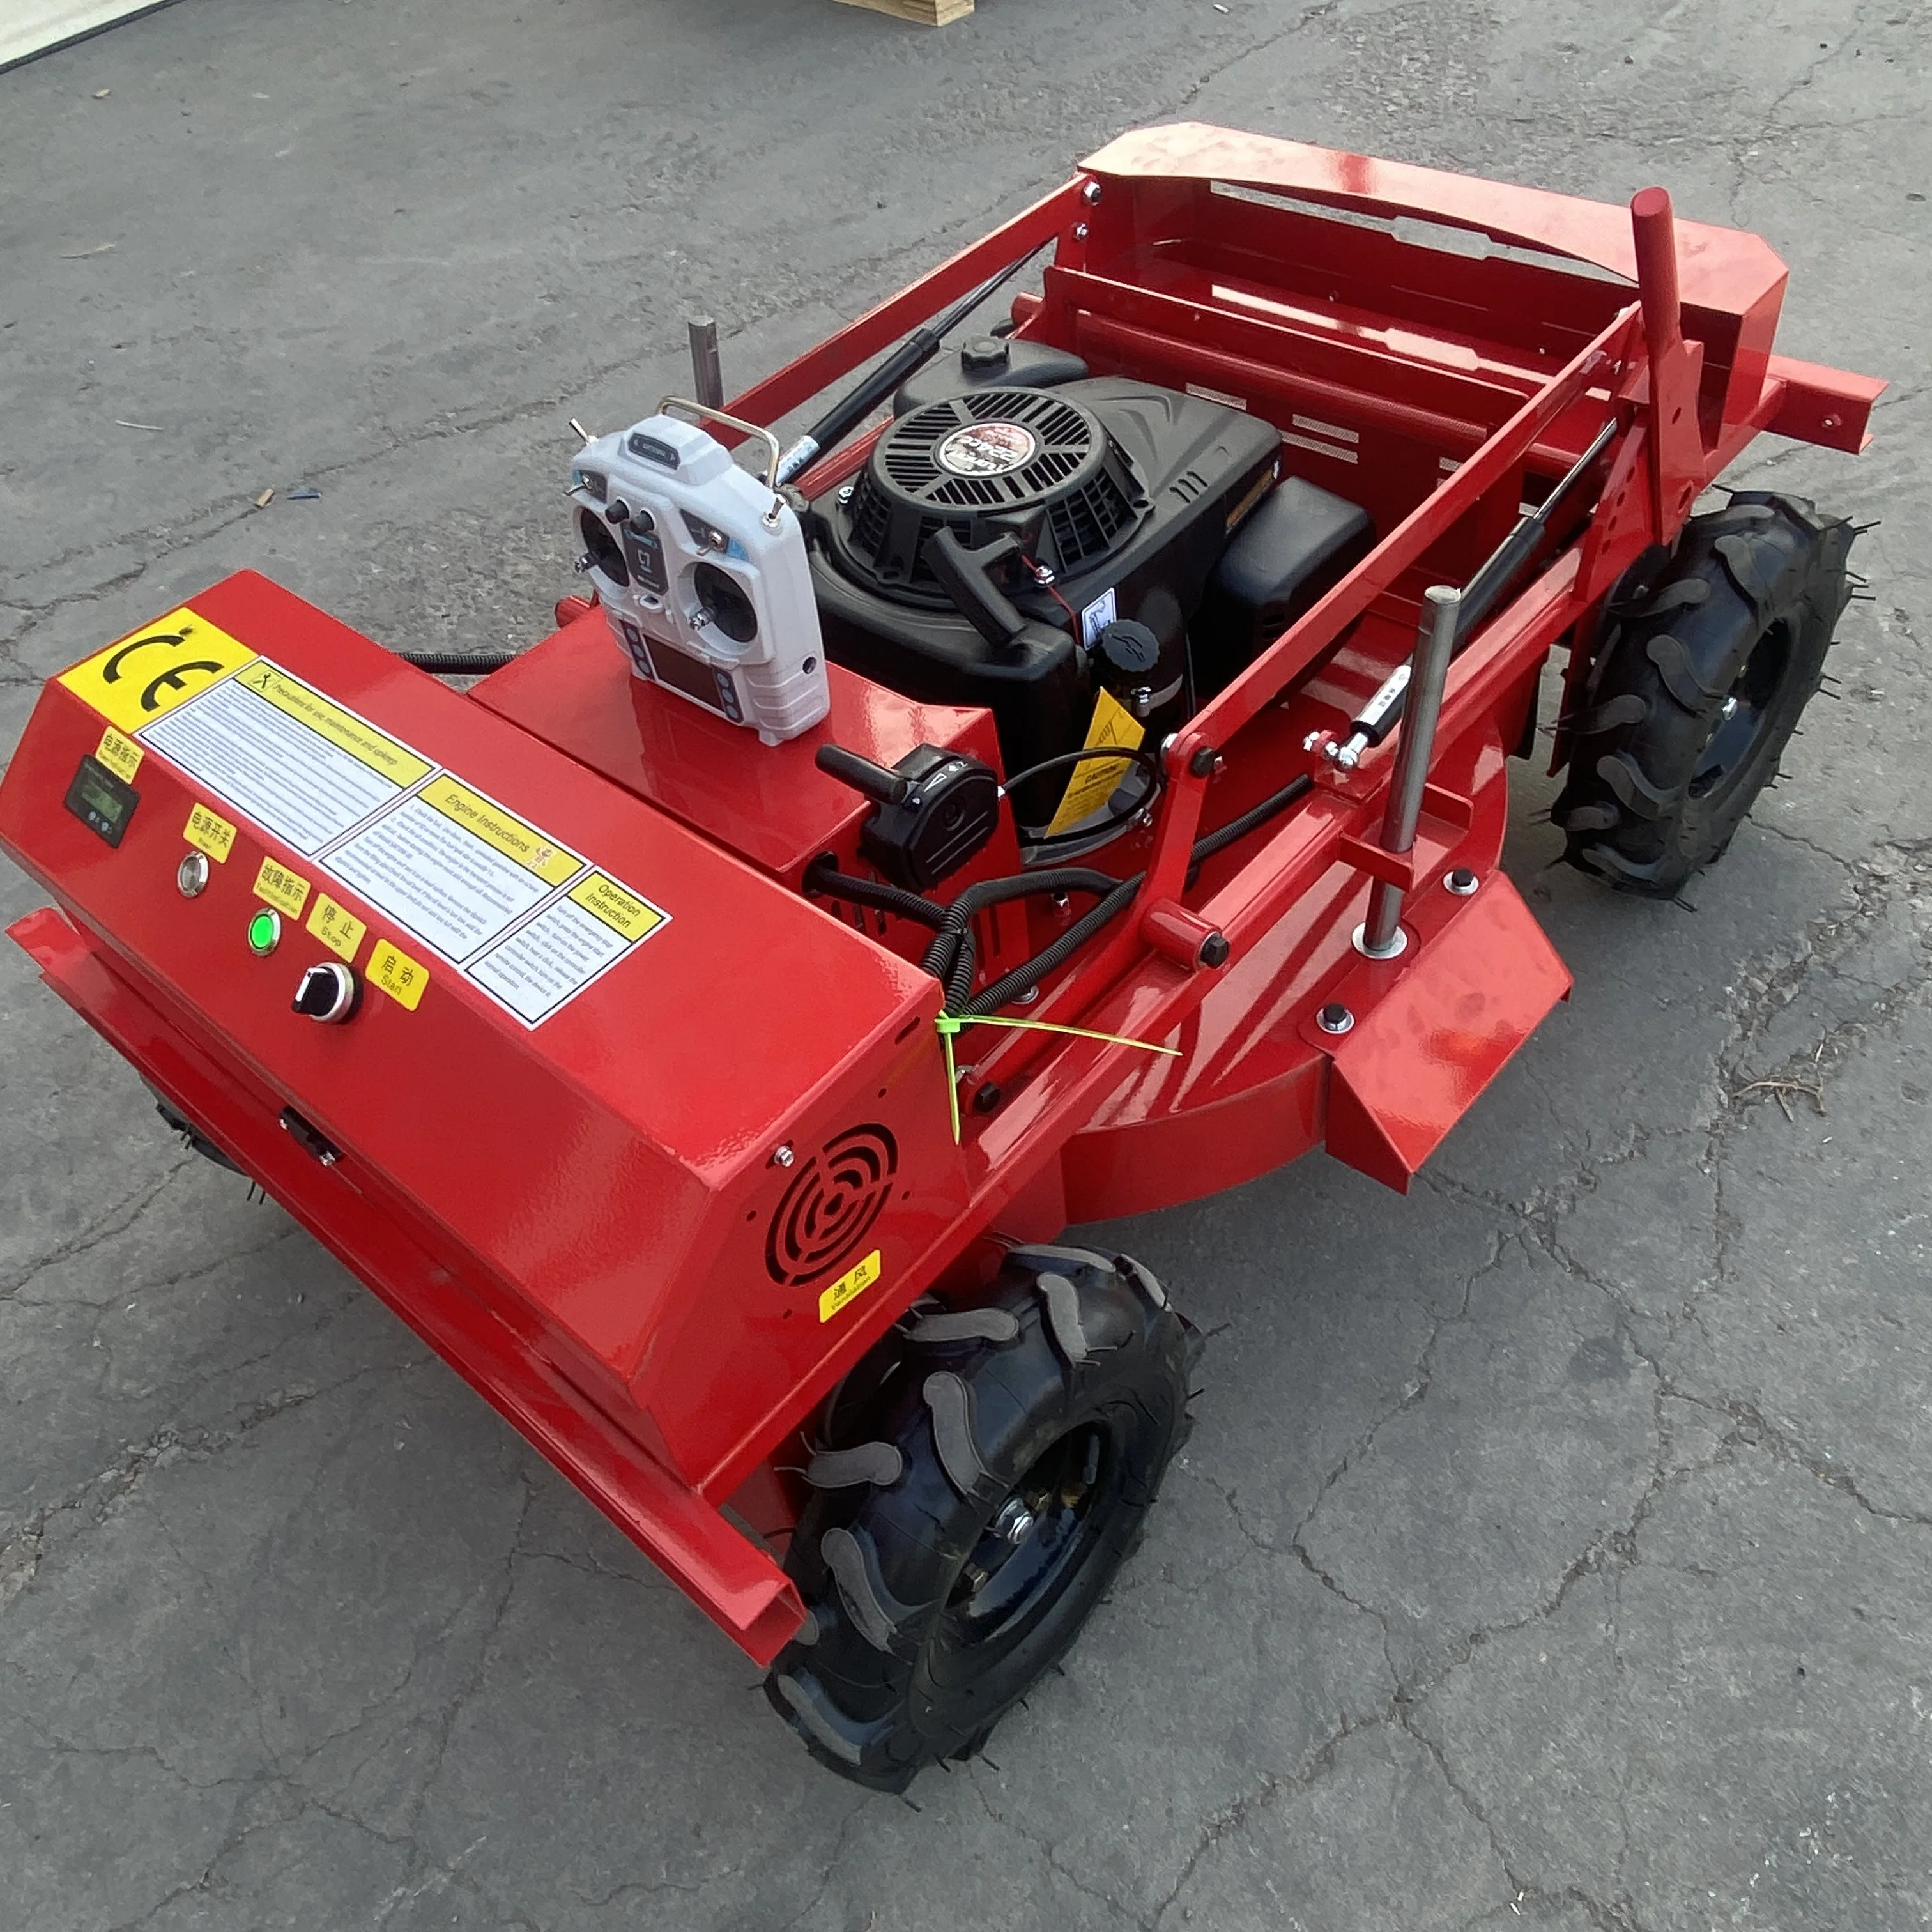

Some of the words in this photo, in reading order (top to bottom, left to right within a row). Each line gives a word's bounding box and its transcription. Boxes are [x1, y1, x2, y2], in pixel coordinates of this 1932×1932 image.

[957, 436, 1018, 462] 224cc
[103, 634, 224, 712] CE
[325, 717, 362, 742] maintenance
[360, 741, 377, 751] and
[192, 812, 229, 847] 电源开关
[445, 794, 477, 818] Engine
[477, 815, 529, 852] Instructions
[262, 864, 303, 900] 故障指示
[586, 893, 630, 927] Instruction
[598, 884, 640, 916] Operation
[321, 926, 341, 946] Stop
[322, 905, 353, 939] 停止
[381, 955, 413, 986] 启动
[834, 1265, 866, 1300] 通风
